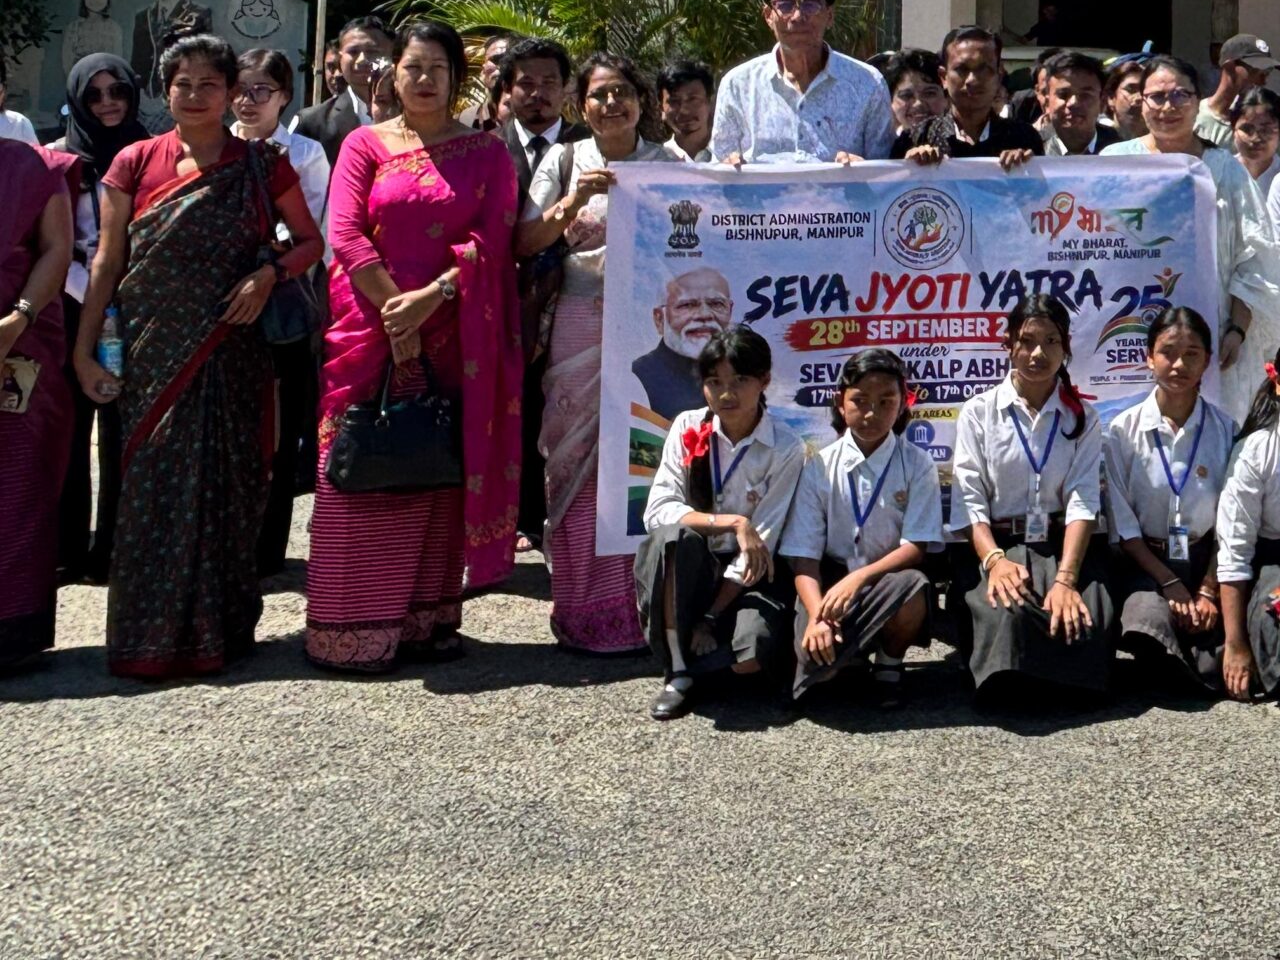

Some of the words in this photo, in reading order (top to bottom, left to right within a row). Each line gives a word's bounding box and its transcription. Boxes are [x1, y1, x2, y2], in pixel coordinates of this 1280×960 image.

[711, 214, 766, 227] DISTRICT
[769, 212, 871, 226] ADMINISTRATION
[725, 227, 803, 241] BISHNUPUR,
[806, 226, 864, 239] MANIPUR
[1062, 239, 1080, 249] MY
[1113, 248, 1161, 259] MANIPUR
[743, 272, 850, 324] SEVA
[855, 271, 971, 314] JYOTI
[979, 268, 1103, 315] YATRA
[809, 319, 861, 346] 28th
[866, 316, 990, 340] SEPTEMBER
[900, 343, 951, 358] under
[1106, 348, 1148, 364] SERV
[800, 362, 842, 384] SEV
[906, 358, 963, 380] KALP
[935, 384, 960, 400] 17th
[923, 409, 953, 419] AREAS
